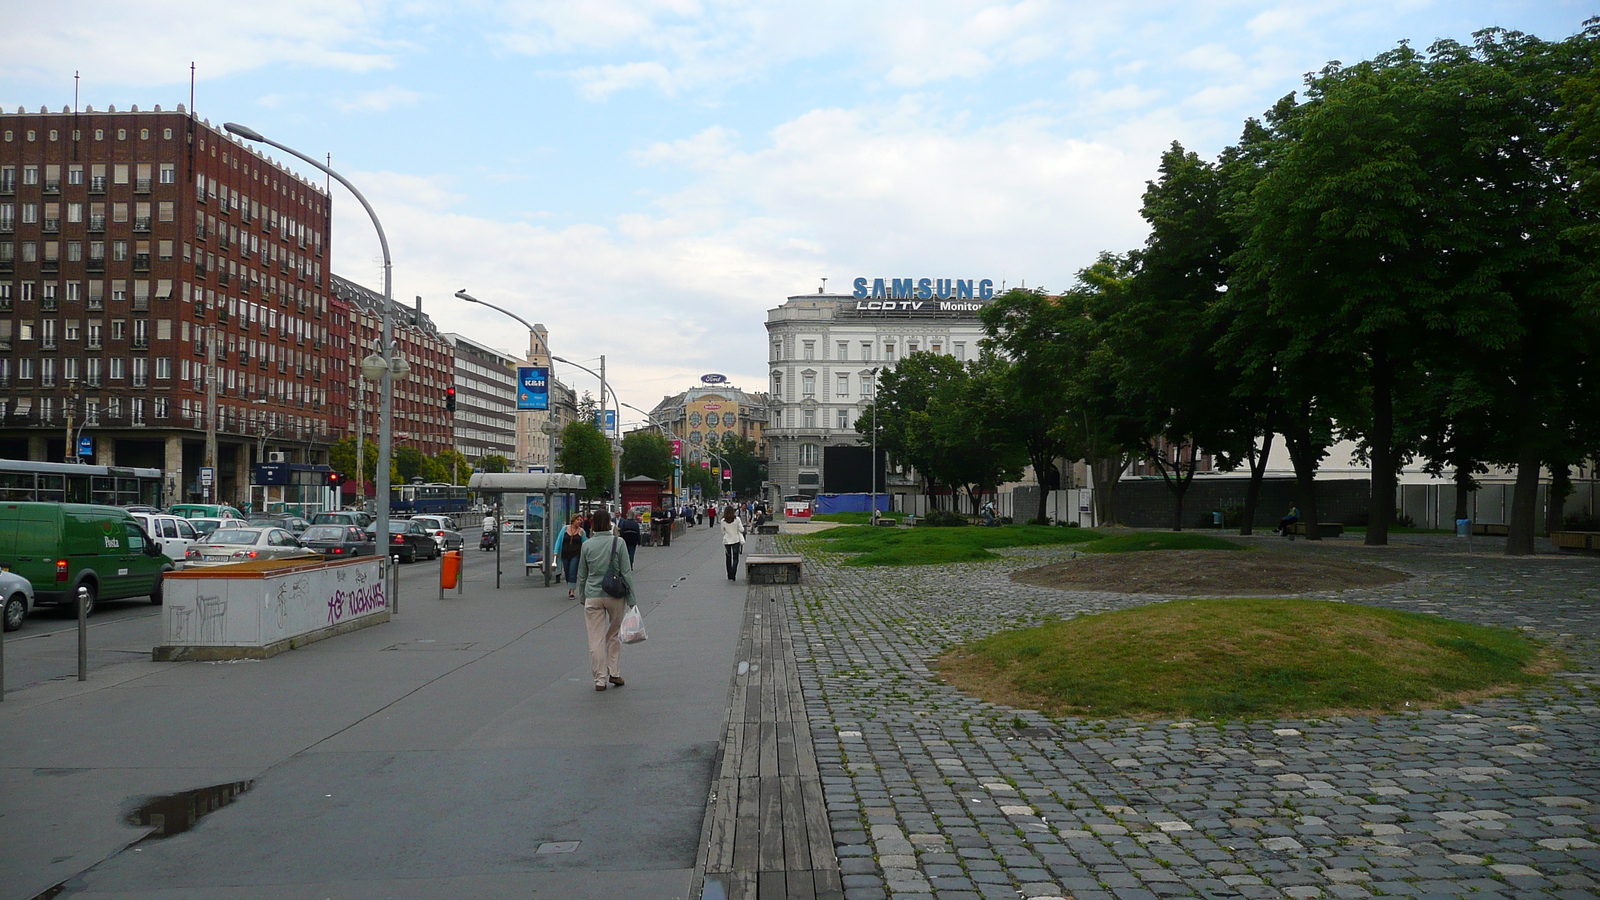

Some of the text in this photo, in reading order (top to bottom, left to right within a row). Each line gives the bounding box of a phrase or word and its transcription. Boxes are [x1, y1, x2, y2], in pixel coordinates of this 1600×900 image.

[852, 276, 994, 300] SAMSUNG
[856, 301, 896, 311] LCD
[898, 301, 923, 311] TV
[705, 374, 722, 383] Ford
[104, 535, 120, 548] Posta
